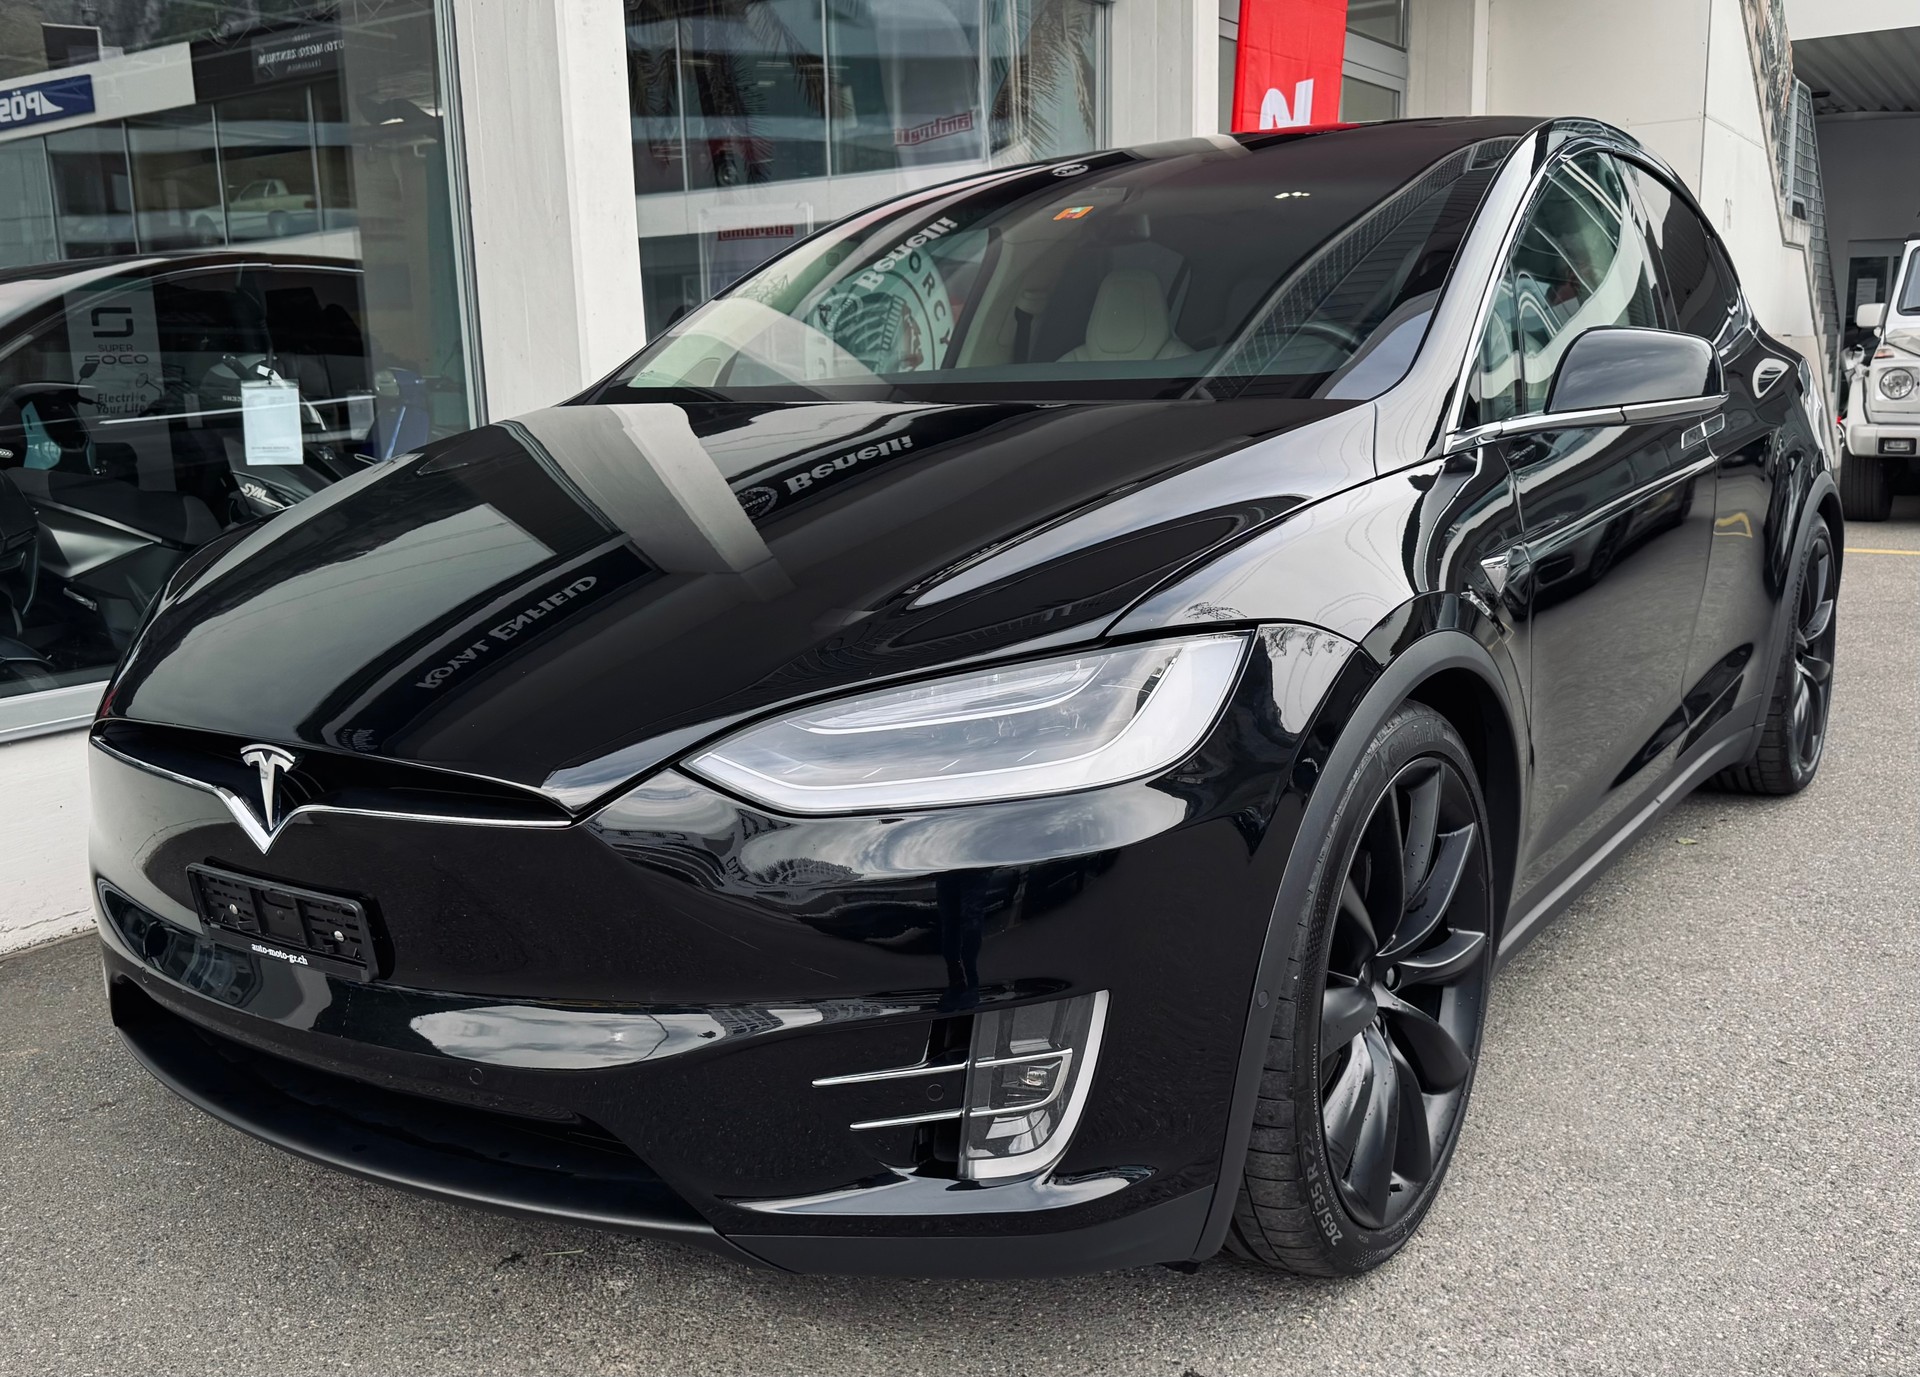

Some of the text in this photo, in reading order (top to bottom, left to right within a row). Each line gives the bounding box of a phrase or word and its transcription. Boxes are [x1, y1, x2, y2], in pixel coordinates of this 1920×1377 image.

[97, 343, 134, 353] SUPER
[84, 354, 149, 365] SOCO
[240, 483, 267, 500] SYM
[1306, 1162, 1320, 1182] R
[1310, 1182, 1343, 1246] 265/35
